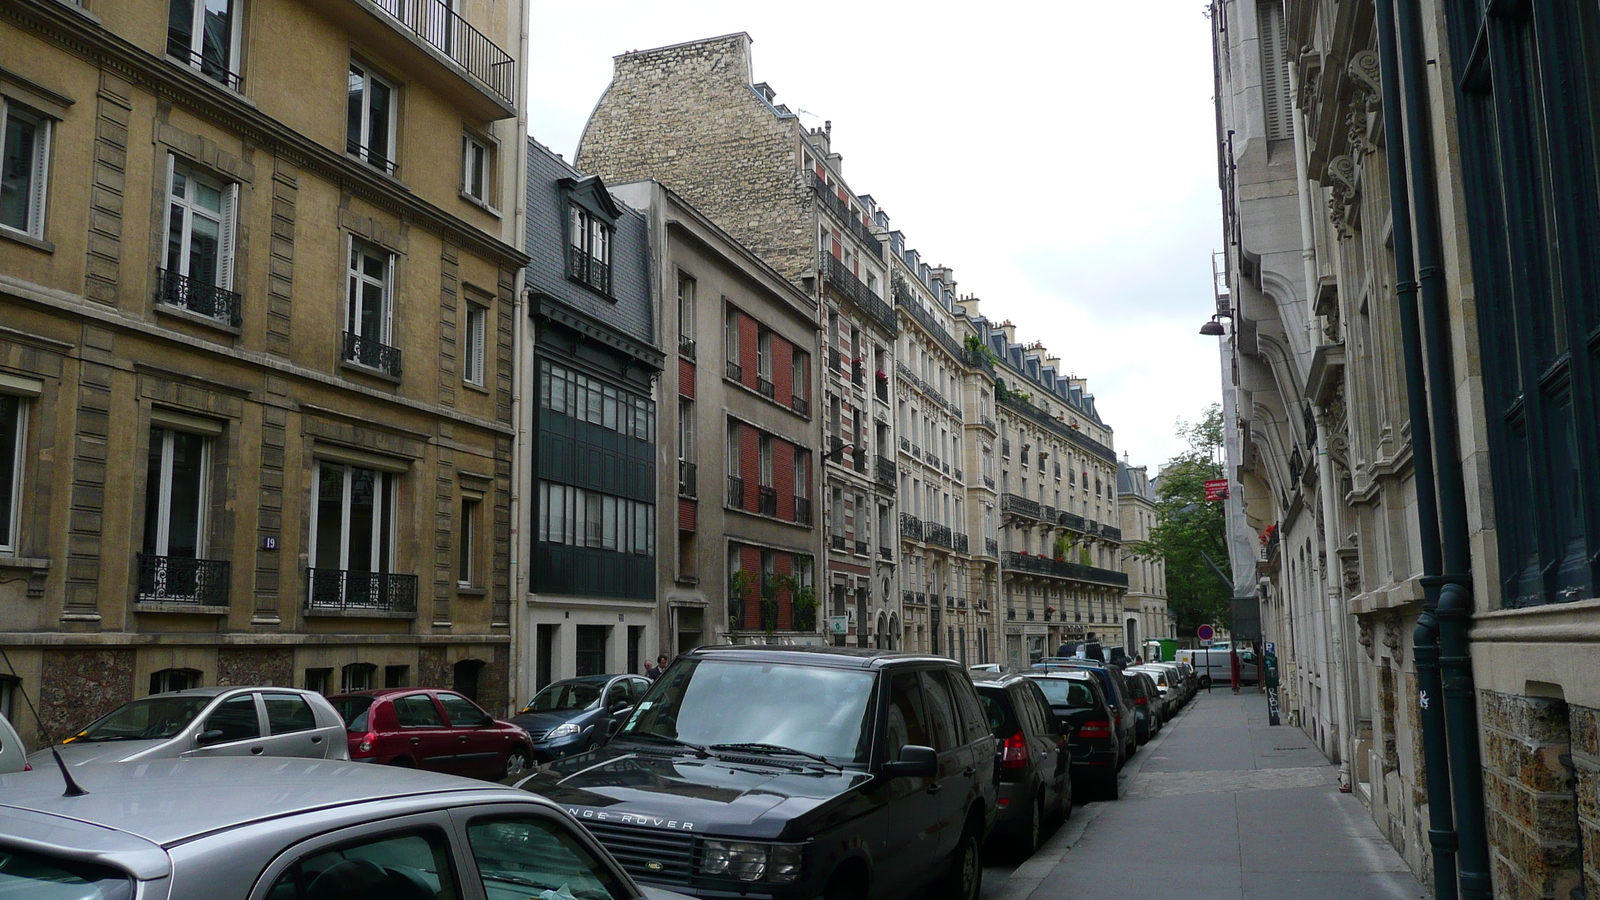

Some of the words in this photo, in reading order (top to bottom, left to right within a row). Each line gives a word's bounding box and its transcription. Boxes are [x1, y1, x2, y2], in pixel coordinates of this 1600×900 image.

[267, 537, 275, 548] 19
[1265, 642, 1273, 652] P
[568, 808, 608, 820] NGE
[621, 815, 694, 831] ROVER
